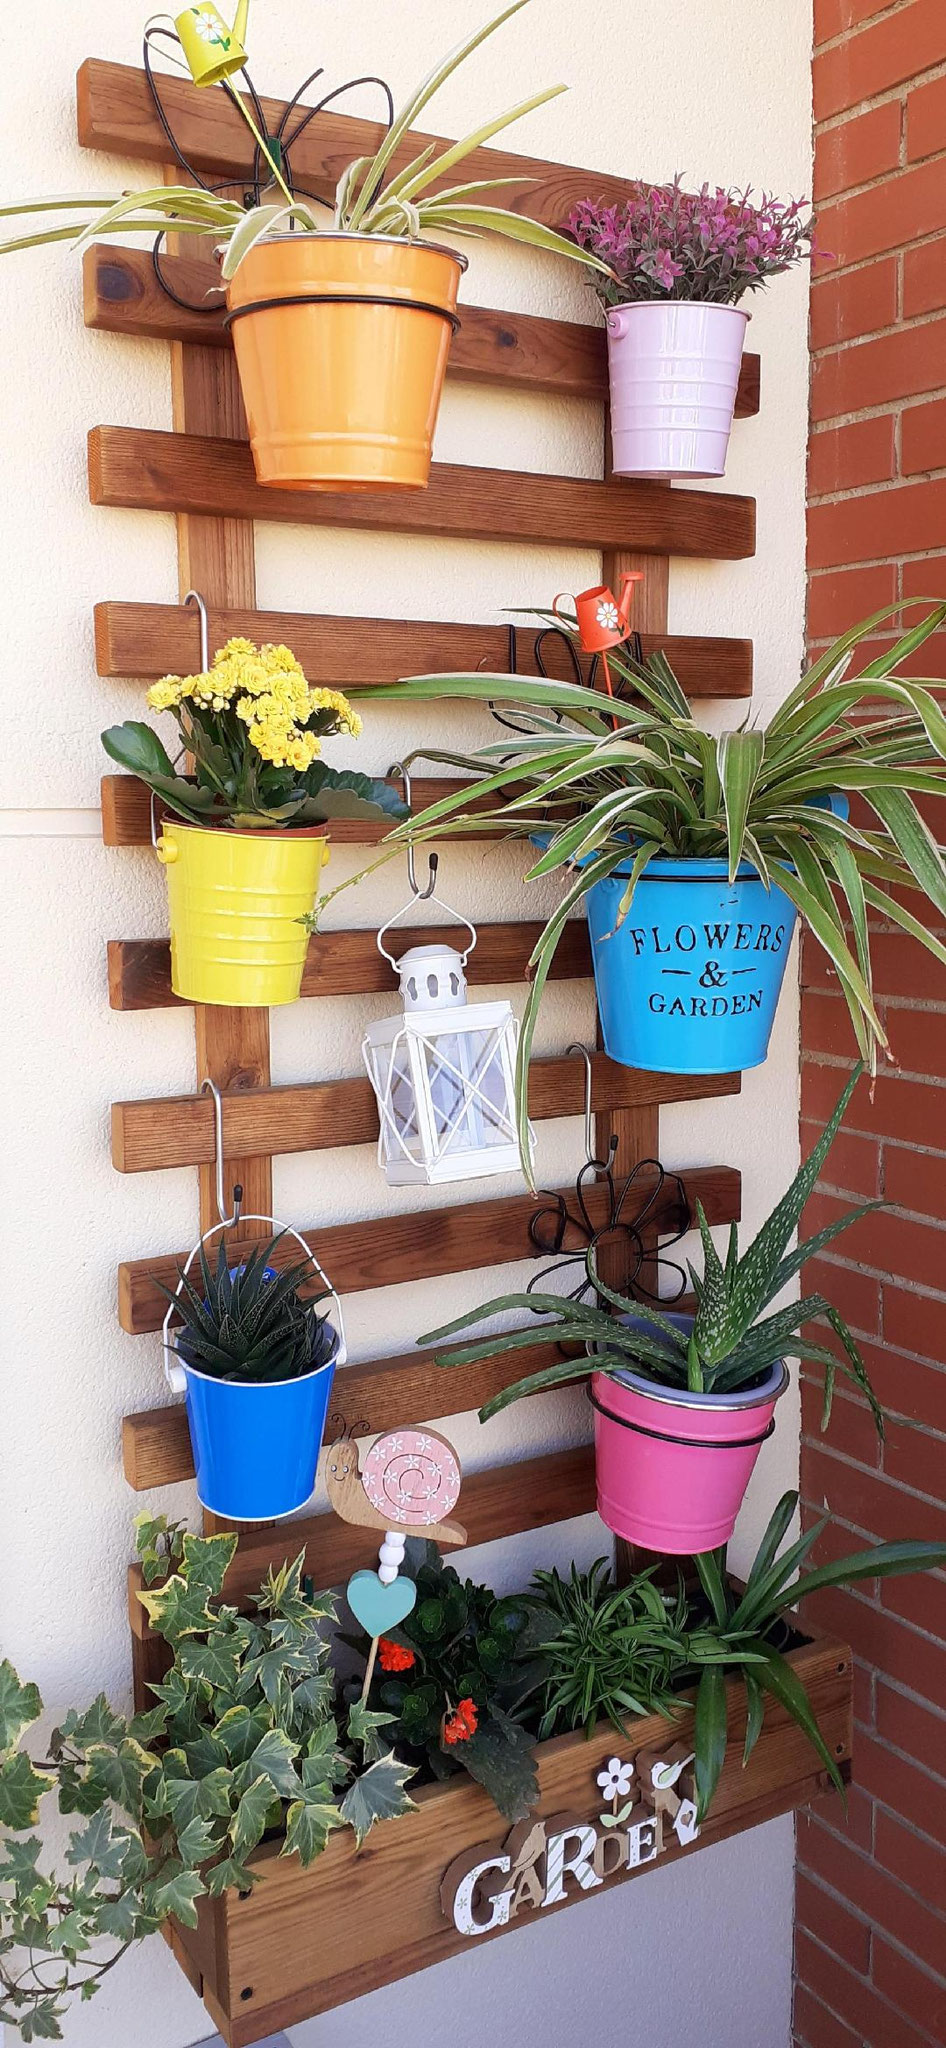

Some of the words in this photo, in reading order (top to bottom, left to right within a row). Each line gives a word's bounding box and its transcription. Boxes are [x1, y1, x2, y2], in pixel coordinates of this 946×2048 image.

[629, 923, 785, 955] FLOWERS
[698, 960, 729, 989] &
[648, 989, 763, 1017] GARDEN
